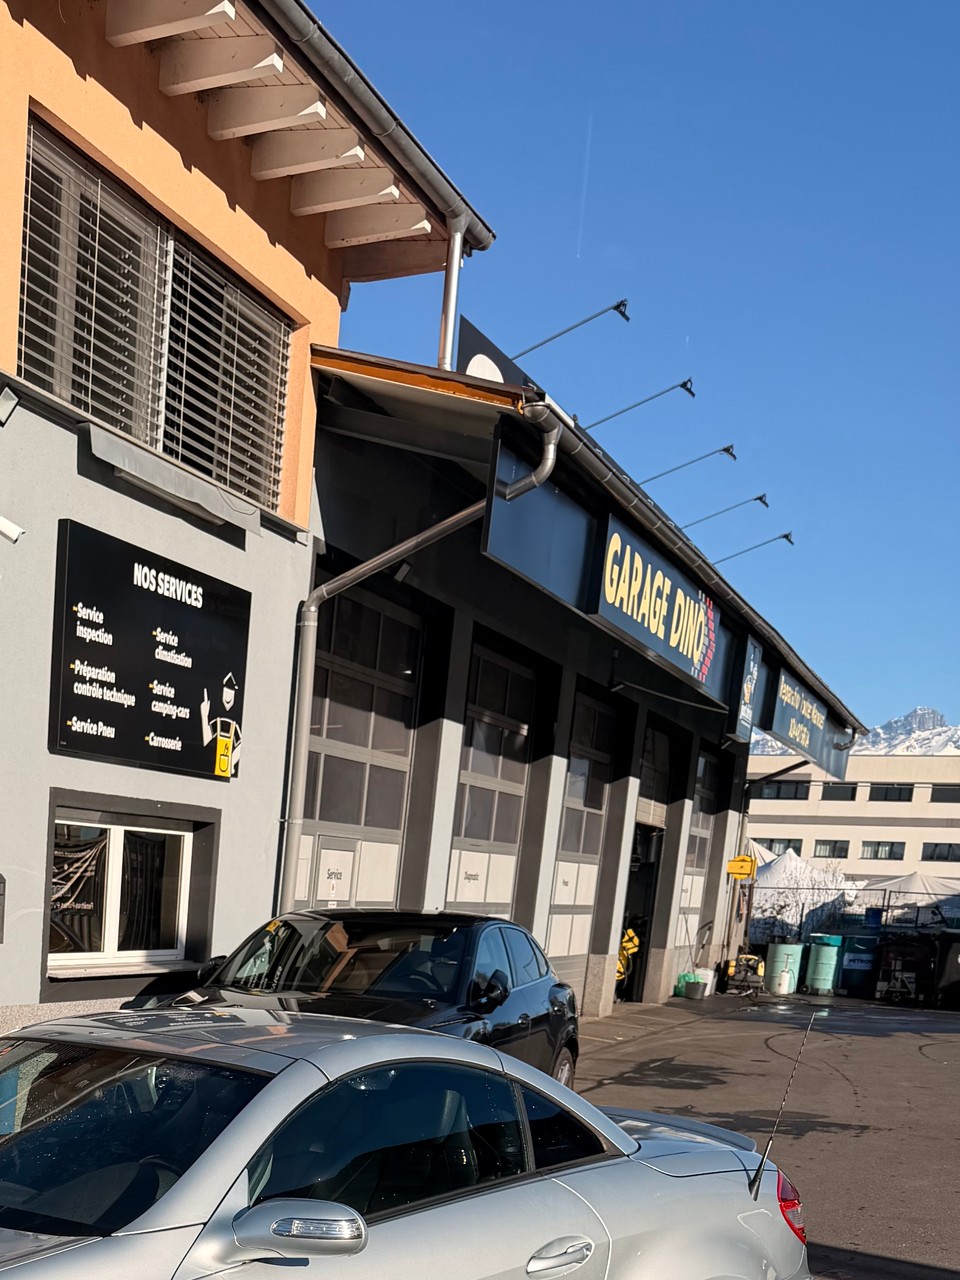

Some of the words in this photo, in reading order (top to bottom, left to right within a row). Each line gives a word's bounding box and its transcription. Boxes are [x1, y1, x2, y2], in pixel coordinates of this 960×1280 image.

[133, 562, 157, 592] NOS
[157, 572, 203, 609] SERVICES
[605, 532, 672, 640] GARAGE
[669, 587, 705, 665] DINO
[77, 602, 104, 624] Service
[76, 620, 113, 646] inspection
[73, 681, 103, 699] contrôle
[103, 686, 136, 708] technique
[151, 700, 190, 719] camping-cars
[71, 715, 98, 736] Service
[97, 721, 116, 739] Pneu
[326, 868, 342, 881] Service
